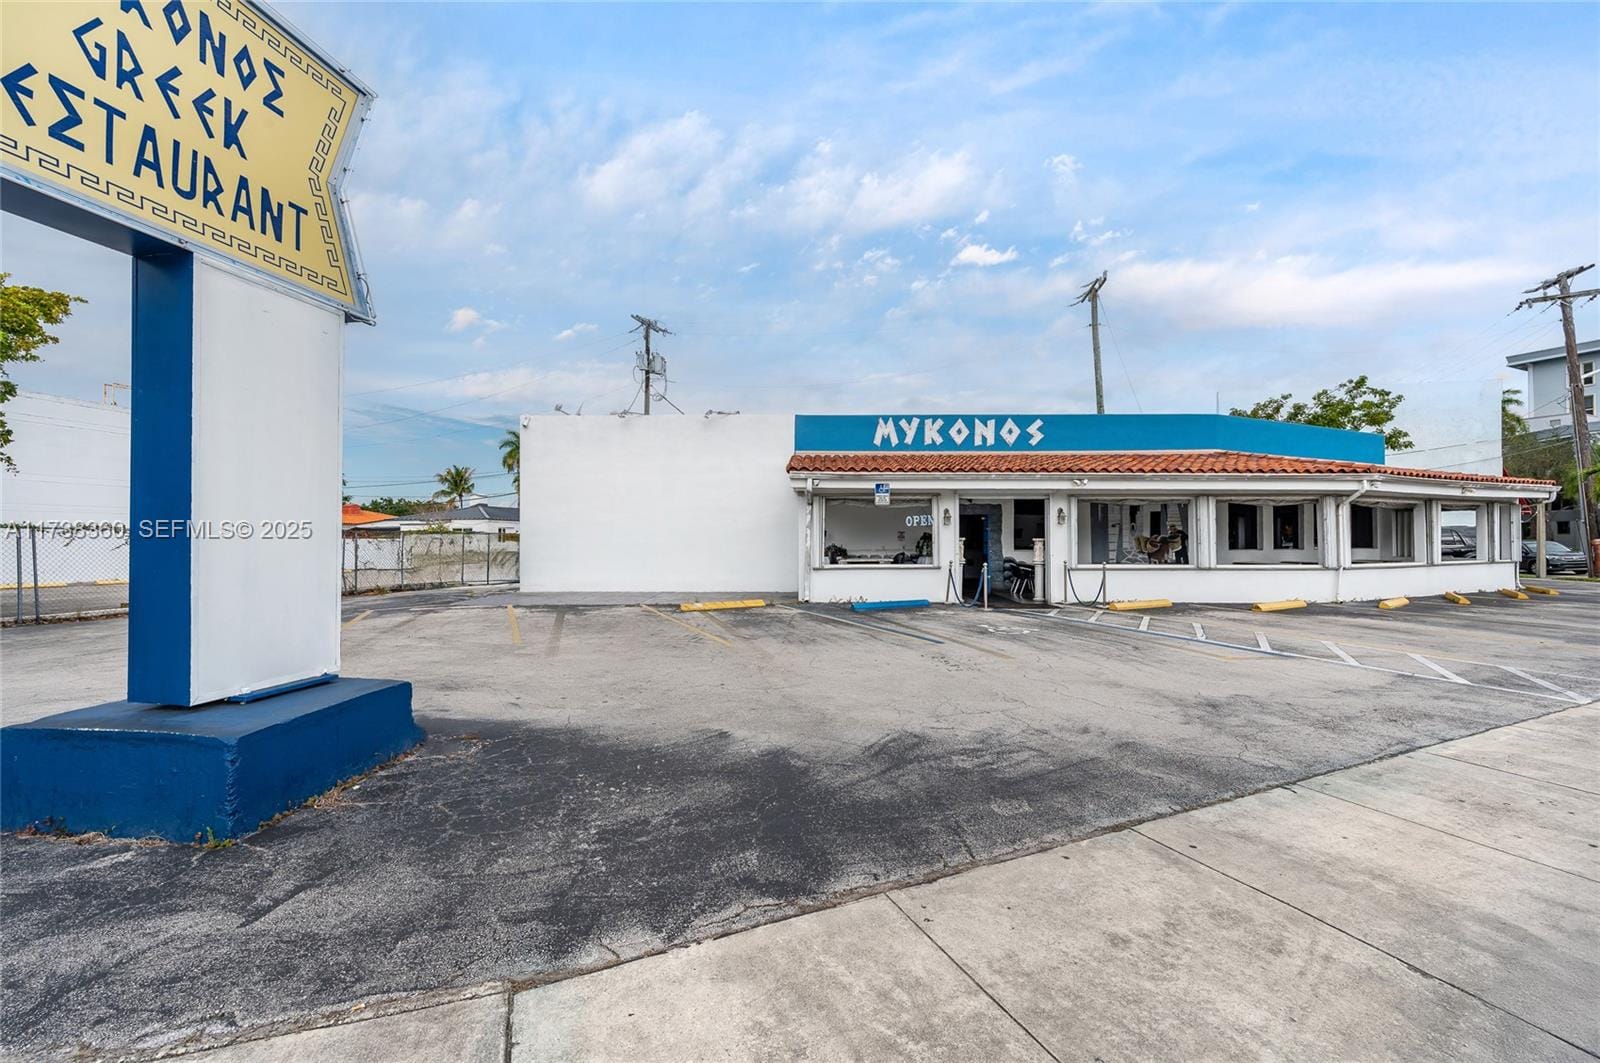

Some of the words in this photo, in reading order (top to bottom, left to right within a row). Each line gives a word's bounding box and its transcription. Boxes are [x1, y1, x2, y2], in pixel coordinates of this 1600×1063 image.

[72, 17, 248, 160] GREEK
[873, 416, 1045, 448] MYKONOS
[905, 514, 934, 527] OPEN
